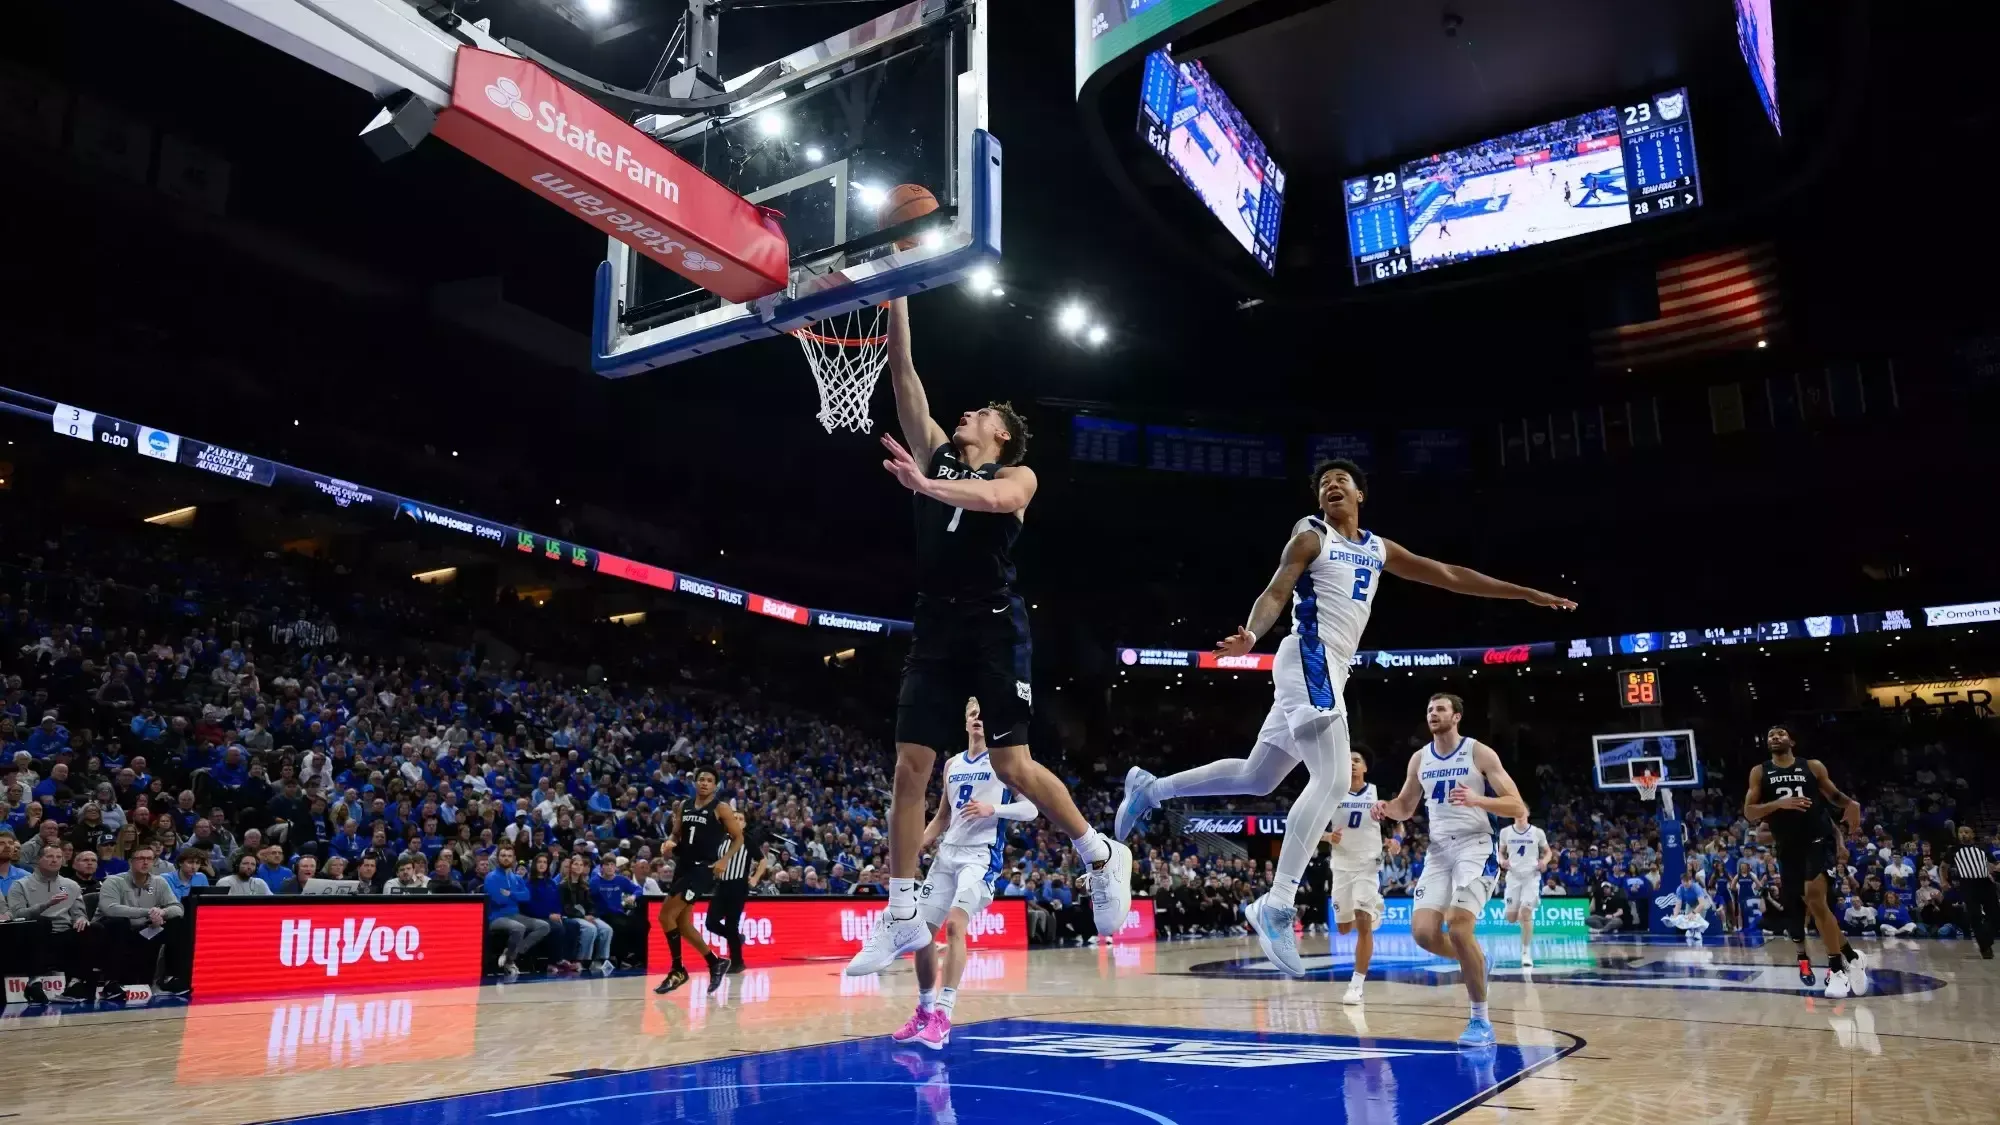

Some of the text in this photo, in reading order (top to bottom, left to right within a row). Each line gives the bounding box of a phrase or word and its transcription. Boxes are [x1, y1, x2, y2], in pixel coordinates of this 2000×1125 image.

[1624, 103, 1651, 126] 23
[1148, 126, 1167, 155] 6:14
[1650, 130, 1665, 140] PTS
[1372, 172, 1397, 193] 29
[1684, 176, 1690, 185] 3
[1634, 196, 1675, 215] 28 1ST
[1376, 258, 1407, 279] 6:14
[72, 409, 80, 421] 3
[69, 424, 78, 436] 0
[115, 422, 120, 431] 1
[101, 432, 129, 448] 0:00
[206, 445, 249, 463] PARKER
[196, 460, 235, 477] AUGUST
[680, 578, 716, 599] BRIDGES
[1352, 568, 1372, 602] 2
[762, 599, 798, 620] Baxter
[1946, 609, 1990, 620] Omaha
[818, 613, 883, 633] ticketmaster
[1771, 622, 1789, 635] 23
[1670, 631, 1687, 644] 29
[1704, 627, 1725, 639] 6:14
[1391, 655, 1412, 667] CHI
[1629, 672, 1655, 684] 6:13
[1628, 683, 1654, 704] 28
[948, 772, 991, 784] CREIGHTON
[1422, 767, 1469, 780] CREIGHTON
[1770, 774, 1806, 785] BUTLER
[956, 785, 973, 809] 9
[682, 815, 707, 824] BUTLER
[1184, 818, 1244, 834] Michelob
[1348, 811, 1362, 828] 0
[689, 826, 696, 844] 1
[1517, 845, 1525, 856] 4
[1547, 907, 1585, 920] ONE
